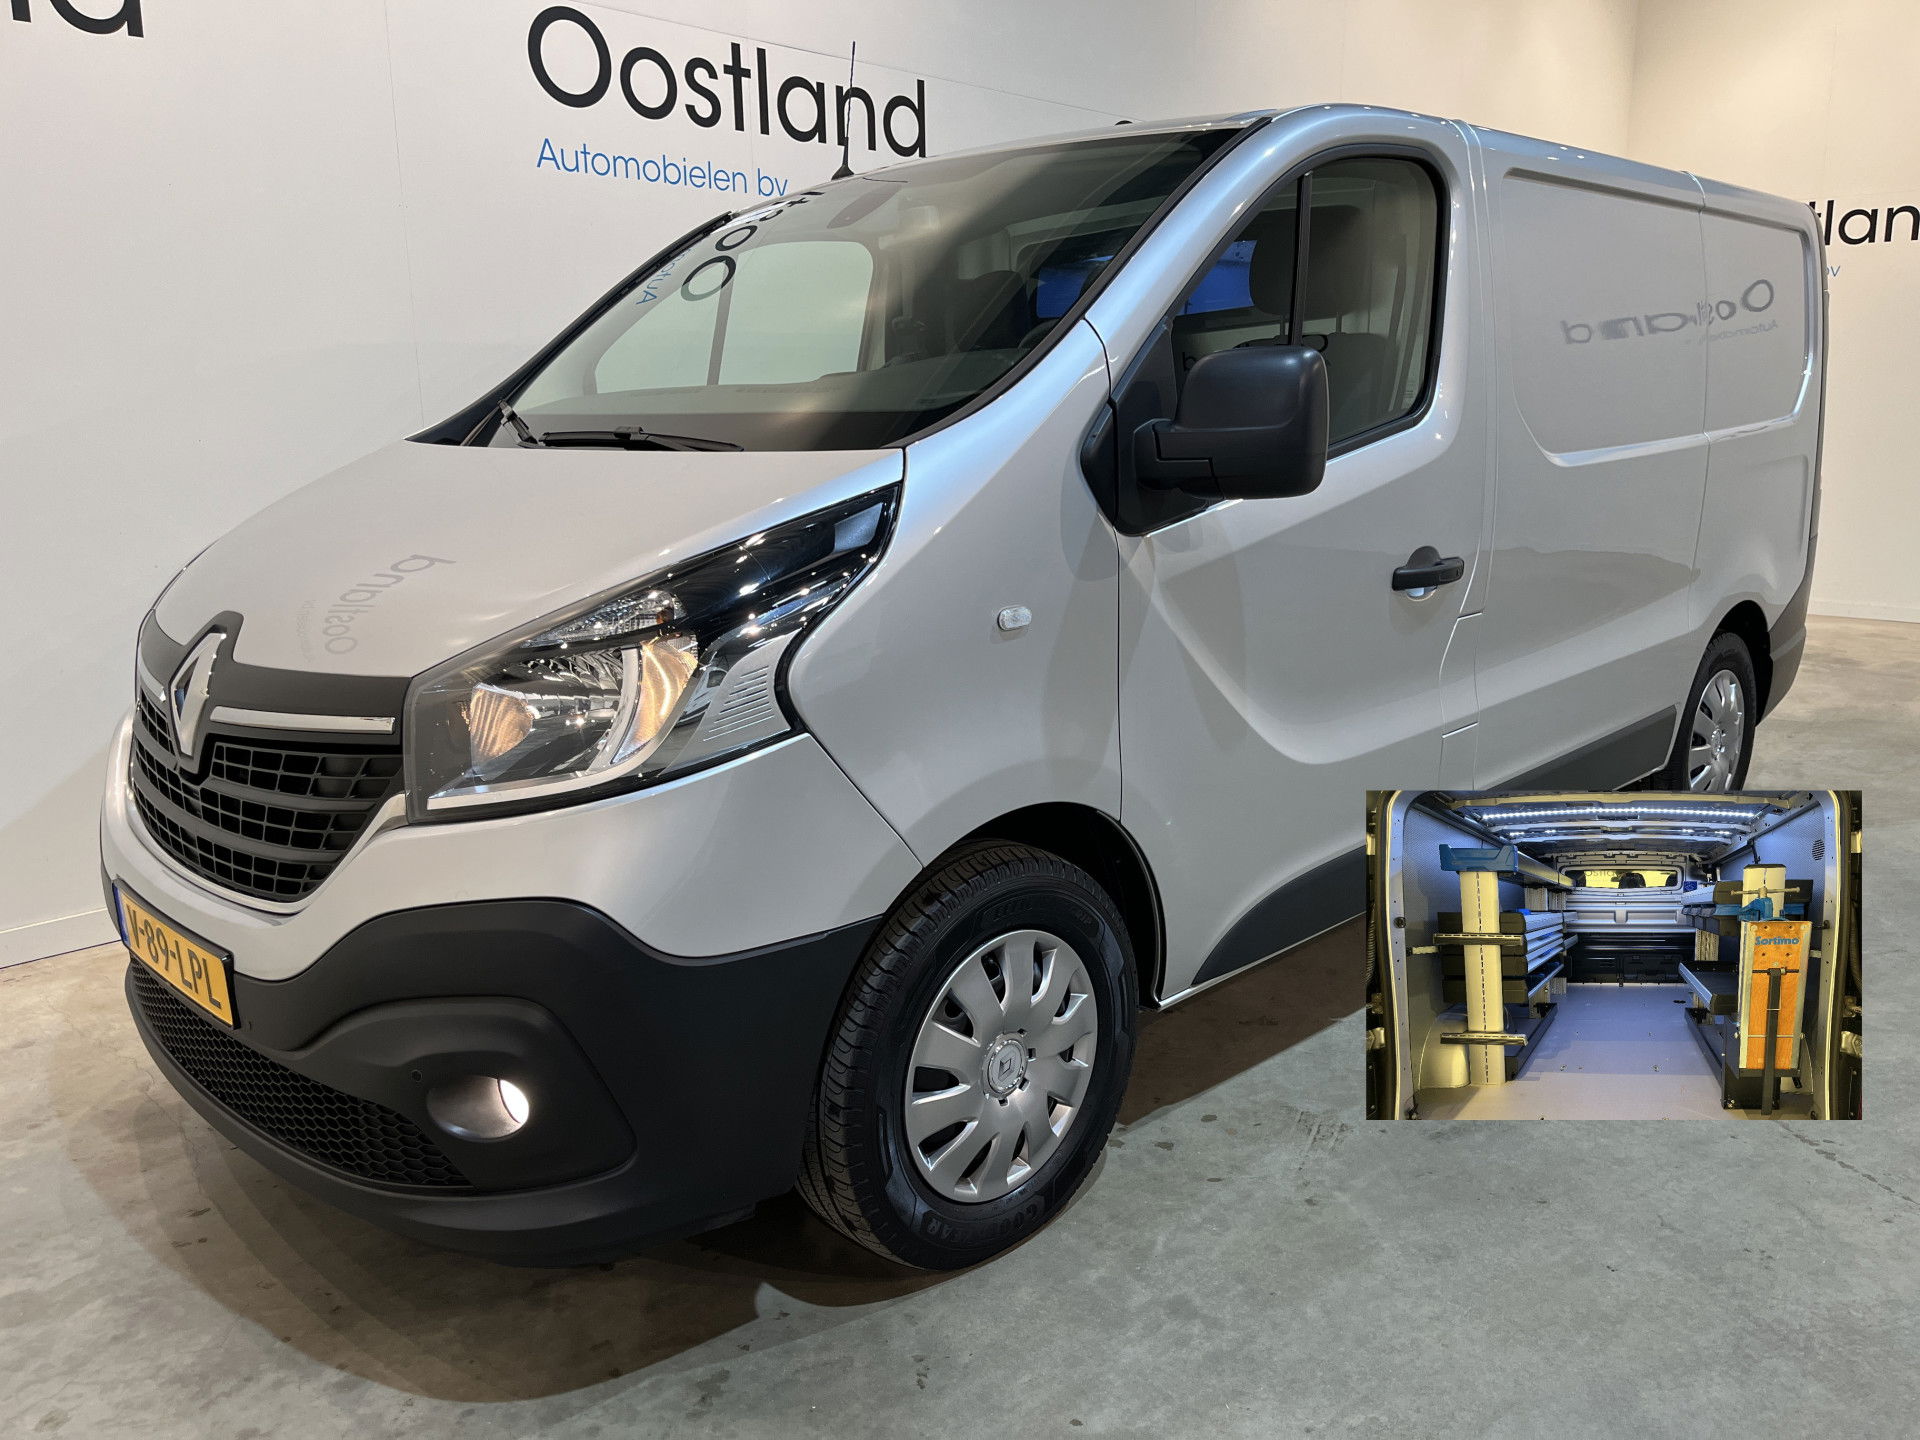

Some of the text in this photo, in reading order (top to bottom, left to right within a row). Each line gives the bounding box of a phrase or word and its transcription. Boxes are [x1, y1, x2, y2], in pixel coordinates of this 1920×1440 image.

[528, 5, 926, 158] Oostland
[537, 138, 788, 197] Automobielen bv
[126, 904, 222, 1010] V-89-LPL
[1755, 935, 1800, 946] Sortimo
